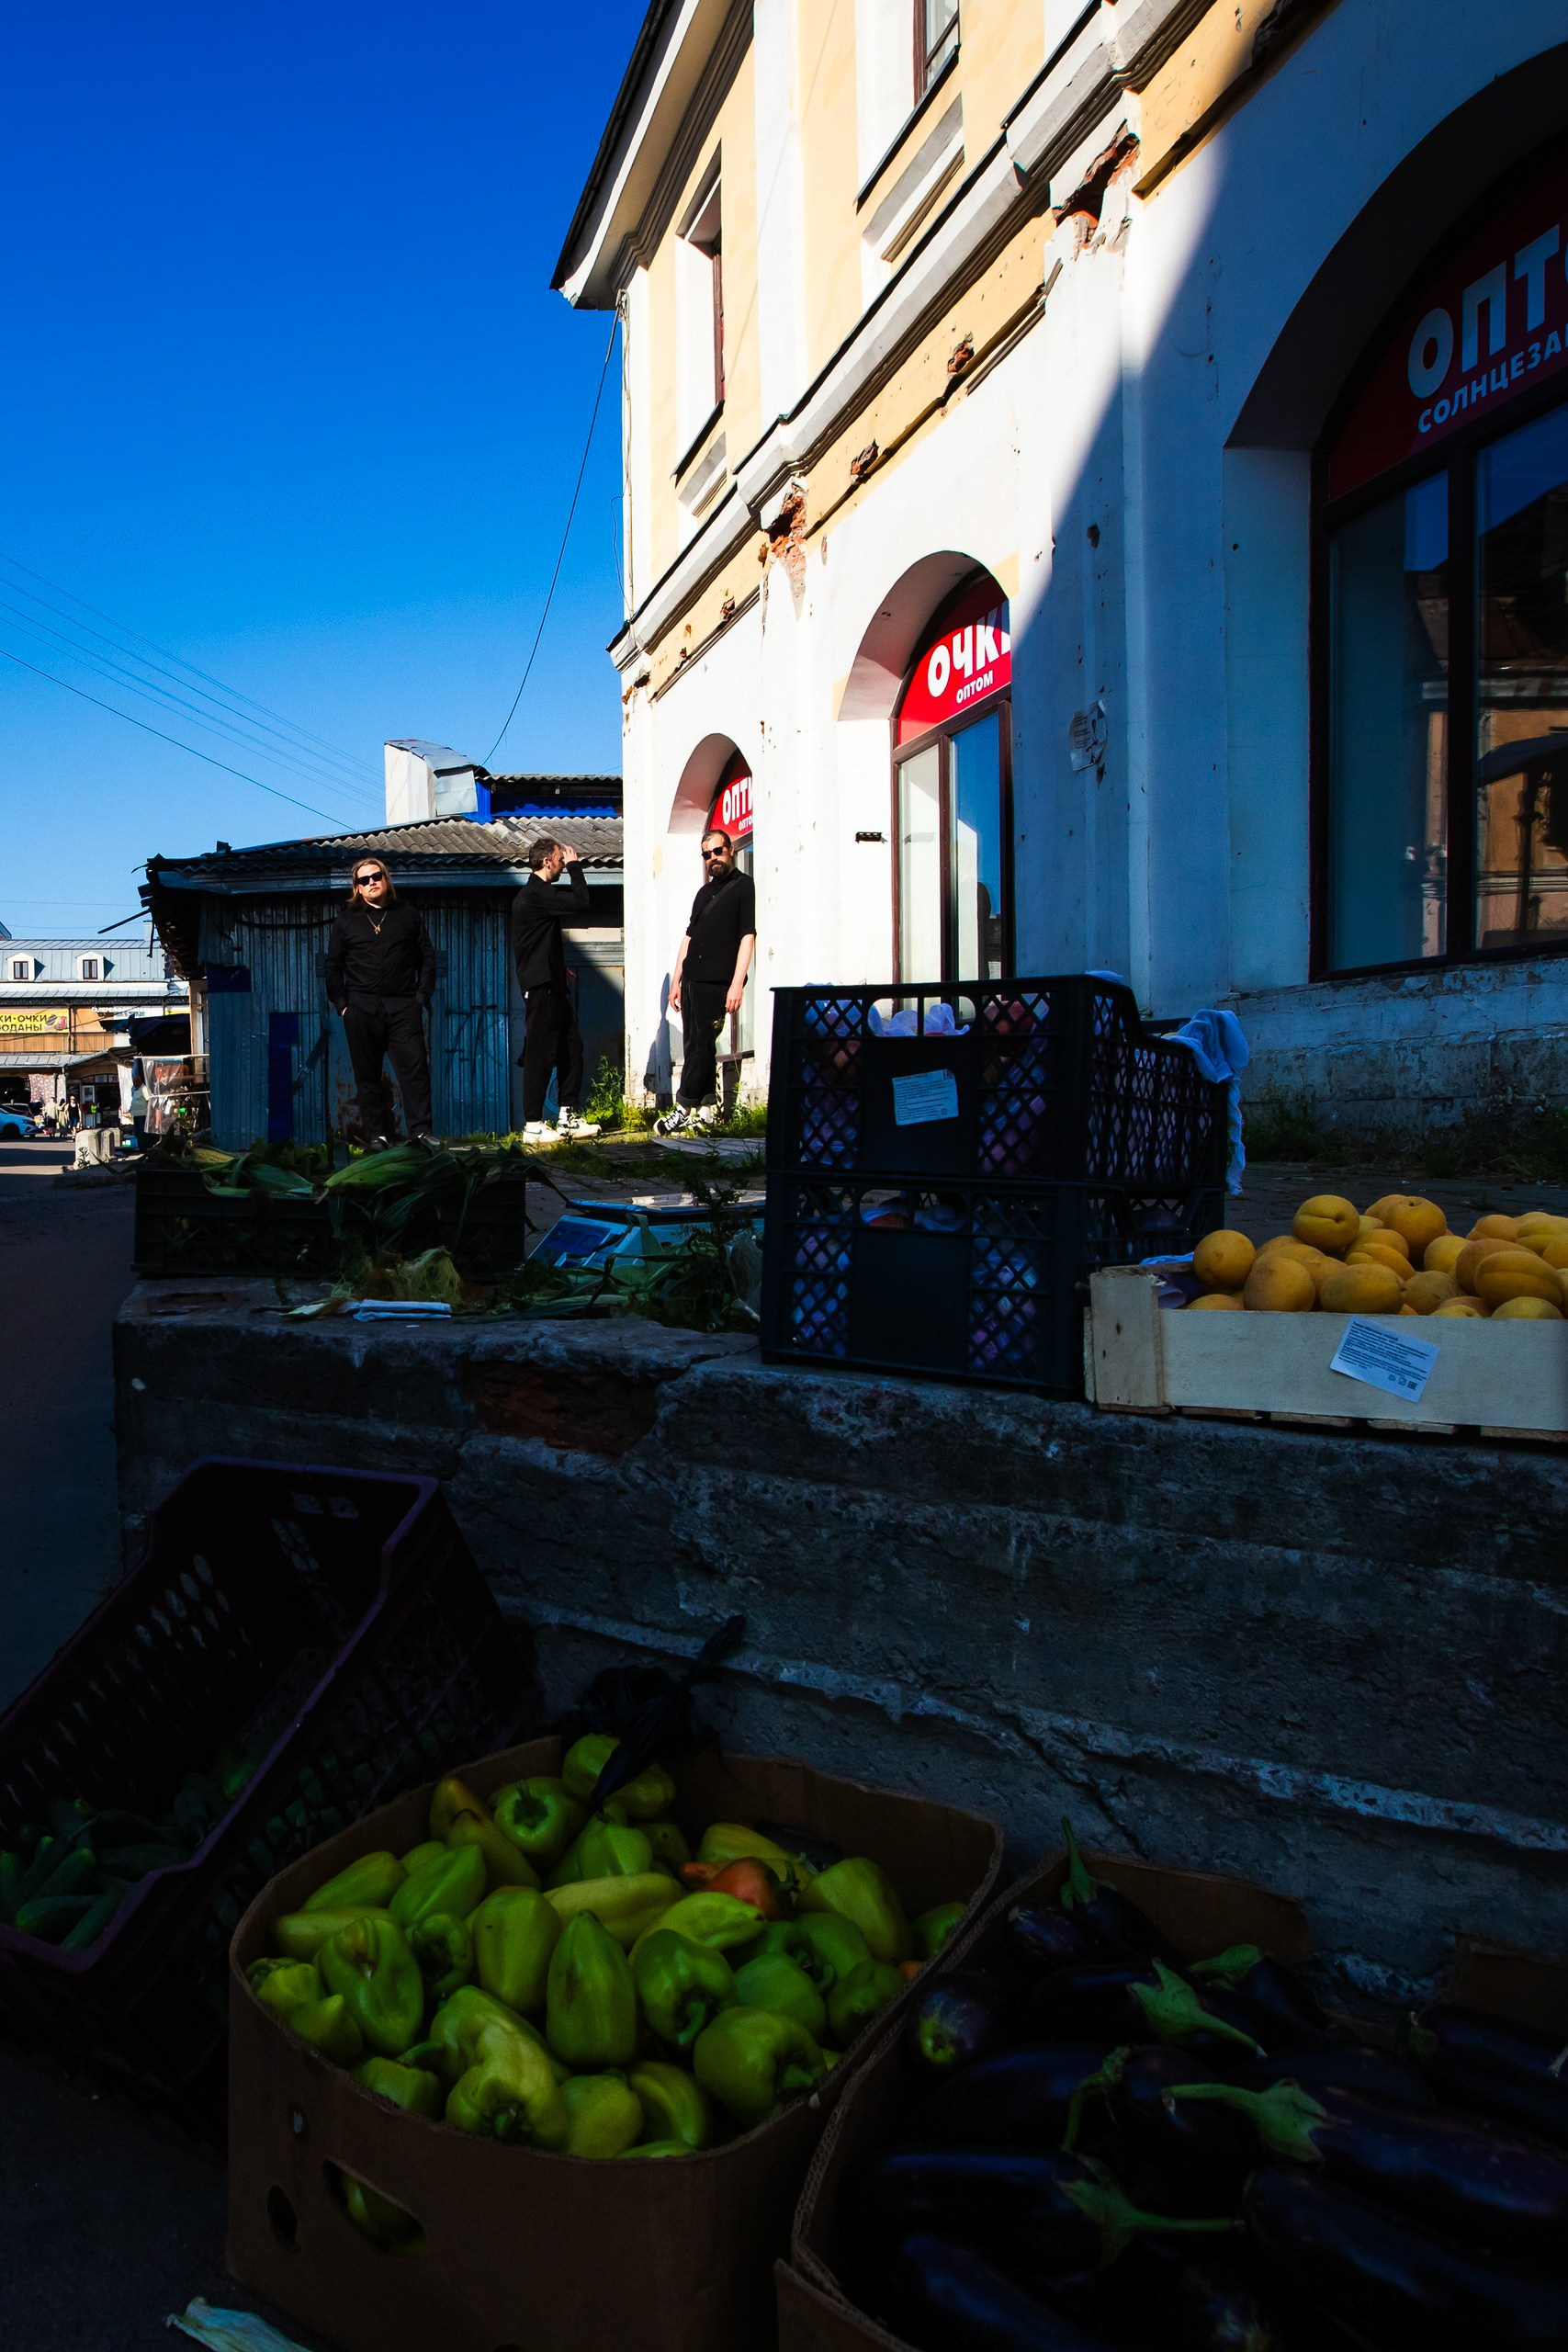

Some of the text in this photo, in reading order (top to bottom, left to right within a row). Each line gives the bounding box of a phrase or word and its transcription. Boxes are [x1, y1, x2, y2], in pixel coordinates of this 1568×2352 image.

[1408, 223, 1568, 399] ОПТ
[1417, 322, 1568, 433] СОЛНЦЕЗА
[956, 670, 993, 704] ОПТОМ
[0, 1023, 42, 1033] ОДАНЫ
[17, 1014, 47, 1023] ОЧКИ
